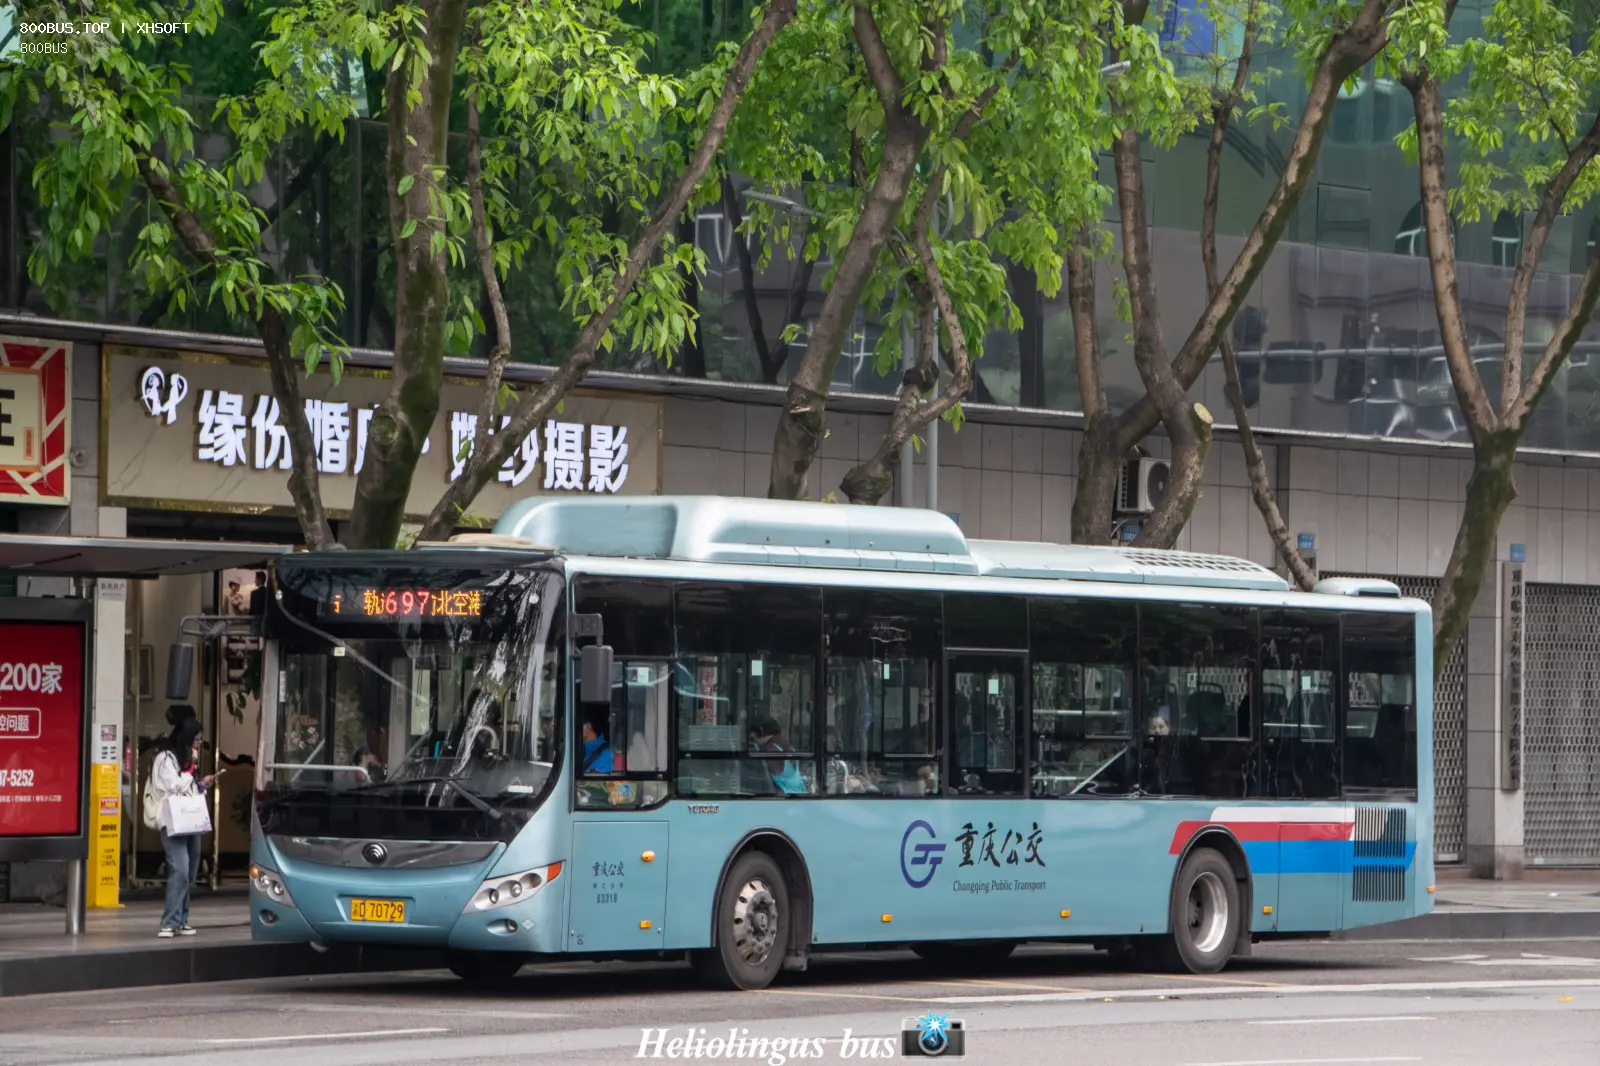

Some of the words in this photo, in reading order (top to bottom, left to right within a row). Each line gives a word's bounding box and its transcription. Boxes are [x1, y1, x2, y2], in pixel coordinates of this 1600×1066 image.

[0, 662, 63, 695] 200家
[954, 821, 1046, 868] 重庆公交
[591, 860, 625, 877] 重庆公交
[952, 880, 990, 894] Chongqing
[991, 880, 1013, 891] Public
[1014, 880, 1046, 892] Transport
